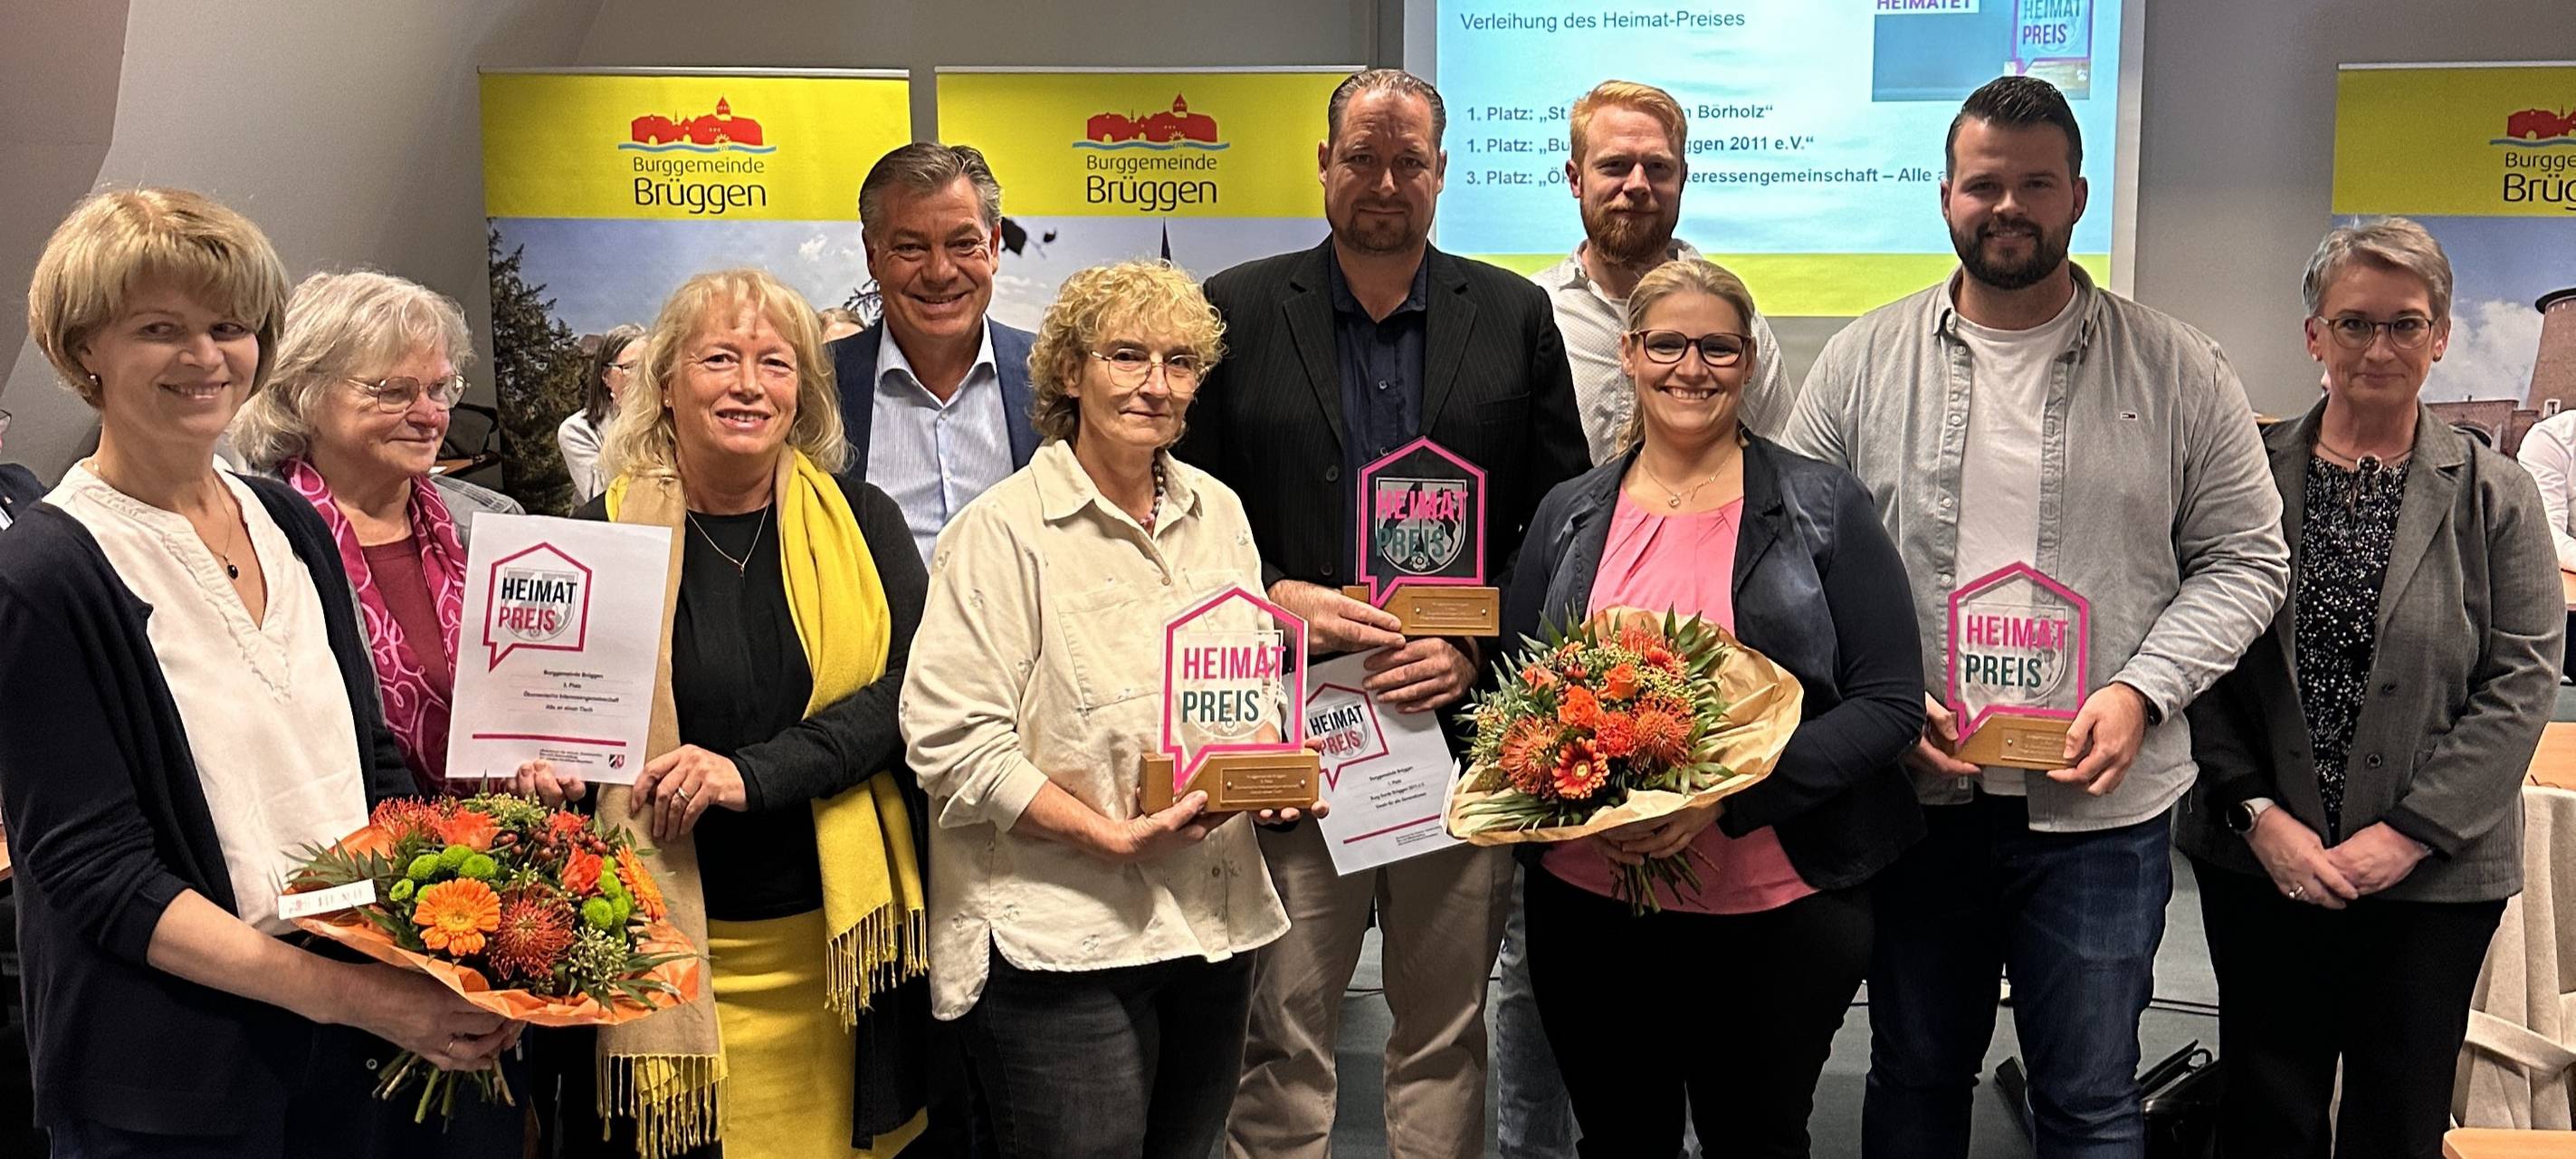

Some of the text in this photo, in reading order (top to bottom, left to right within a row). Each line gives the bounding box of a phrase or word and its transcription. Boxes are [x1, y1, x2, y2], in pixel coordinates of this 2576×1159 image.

[1877, 0, 1970, 9] HEIMATET
[2023, 0, 2080, 19] HEIMAT
[1460, 10, 1745, 33] Verleihung des Heimat-Preises
[2022, 24, 2067, 45] PREIS
[1466, 107, 1482, 120] 1.
[1487, 107, 1533, 120] Platz:
[1466, 139, 1482, 153] 1.
[1487, 139, 1533, 152] Platz:
[1730, 137, 1768, 150] 2011
[633, 156, 765, 177] Burggemeinde
[1086, 154, 1217, 174] Burggemeinde
[1466, 171, 1481, 185] 3.
[1486, 170, 1532, 184] Platz:
[1897, 168, 1932, 182] Alle
[634, 177, 767, 215] Brüggen
[1086, 175, 1217, 212] Brüggen
[1377, 489, 1468, 522] HEIMAT
[1375, 527, 1447, 559] PREIS
[501, 577, 577, 605] HEIMAT
[498, 606, 558, 632] PREIS
[1966, 614, 2069, 653] HEIMAT
[1183, 646, 1286, 680] HEIMAT
[1965, 653, 2042, 687] PREIS
[1182, 689, 1260, 723] PREIS
[1309, 704, 1364, 735] HEIMAT
[1320, 730, 1361, 756] PREIS
